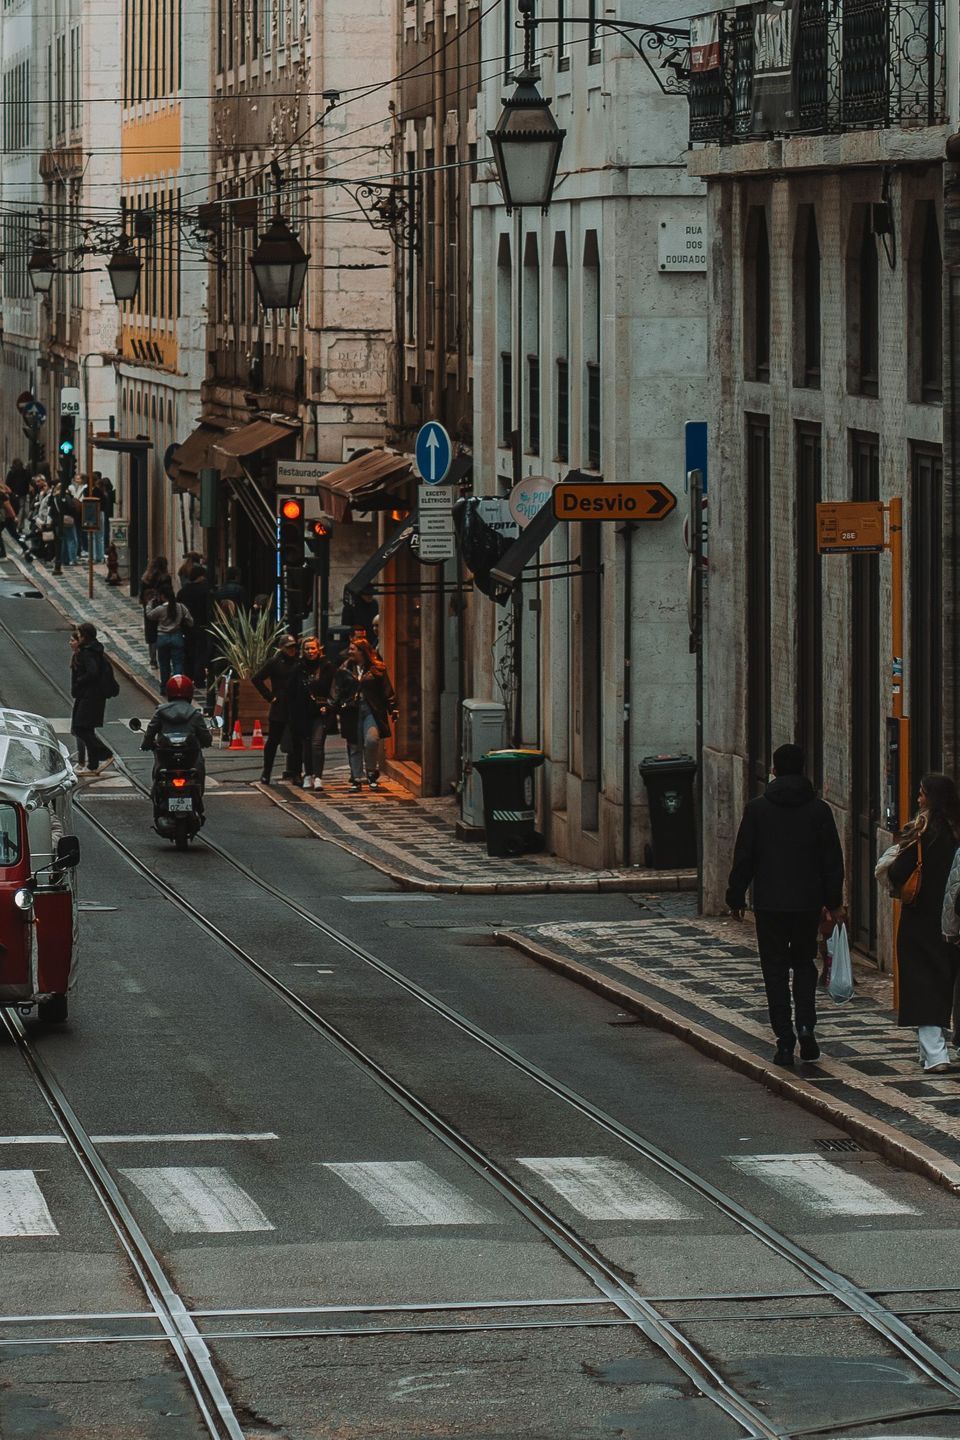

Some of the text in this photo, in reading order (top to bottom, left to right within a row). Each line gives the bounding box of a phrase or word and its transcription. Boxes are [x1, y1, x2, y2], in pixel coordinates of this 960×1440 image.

[685, 226, 703, 235] RUA
[686, 241, 703, 249] DOS
[61, 402, 80, 411] P&B
[563, 493, 637, 512] Desvio
